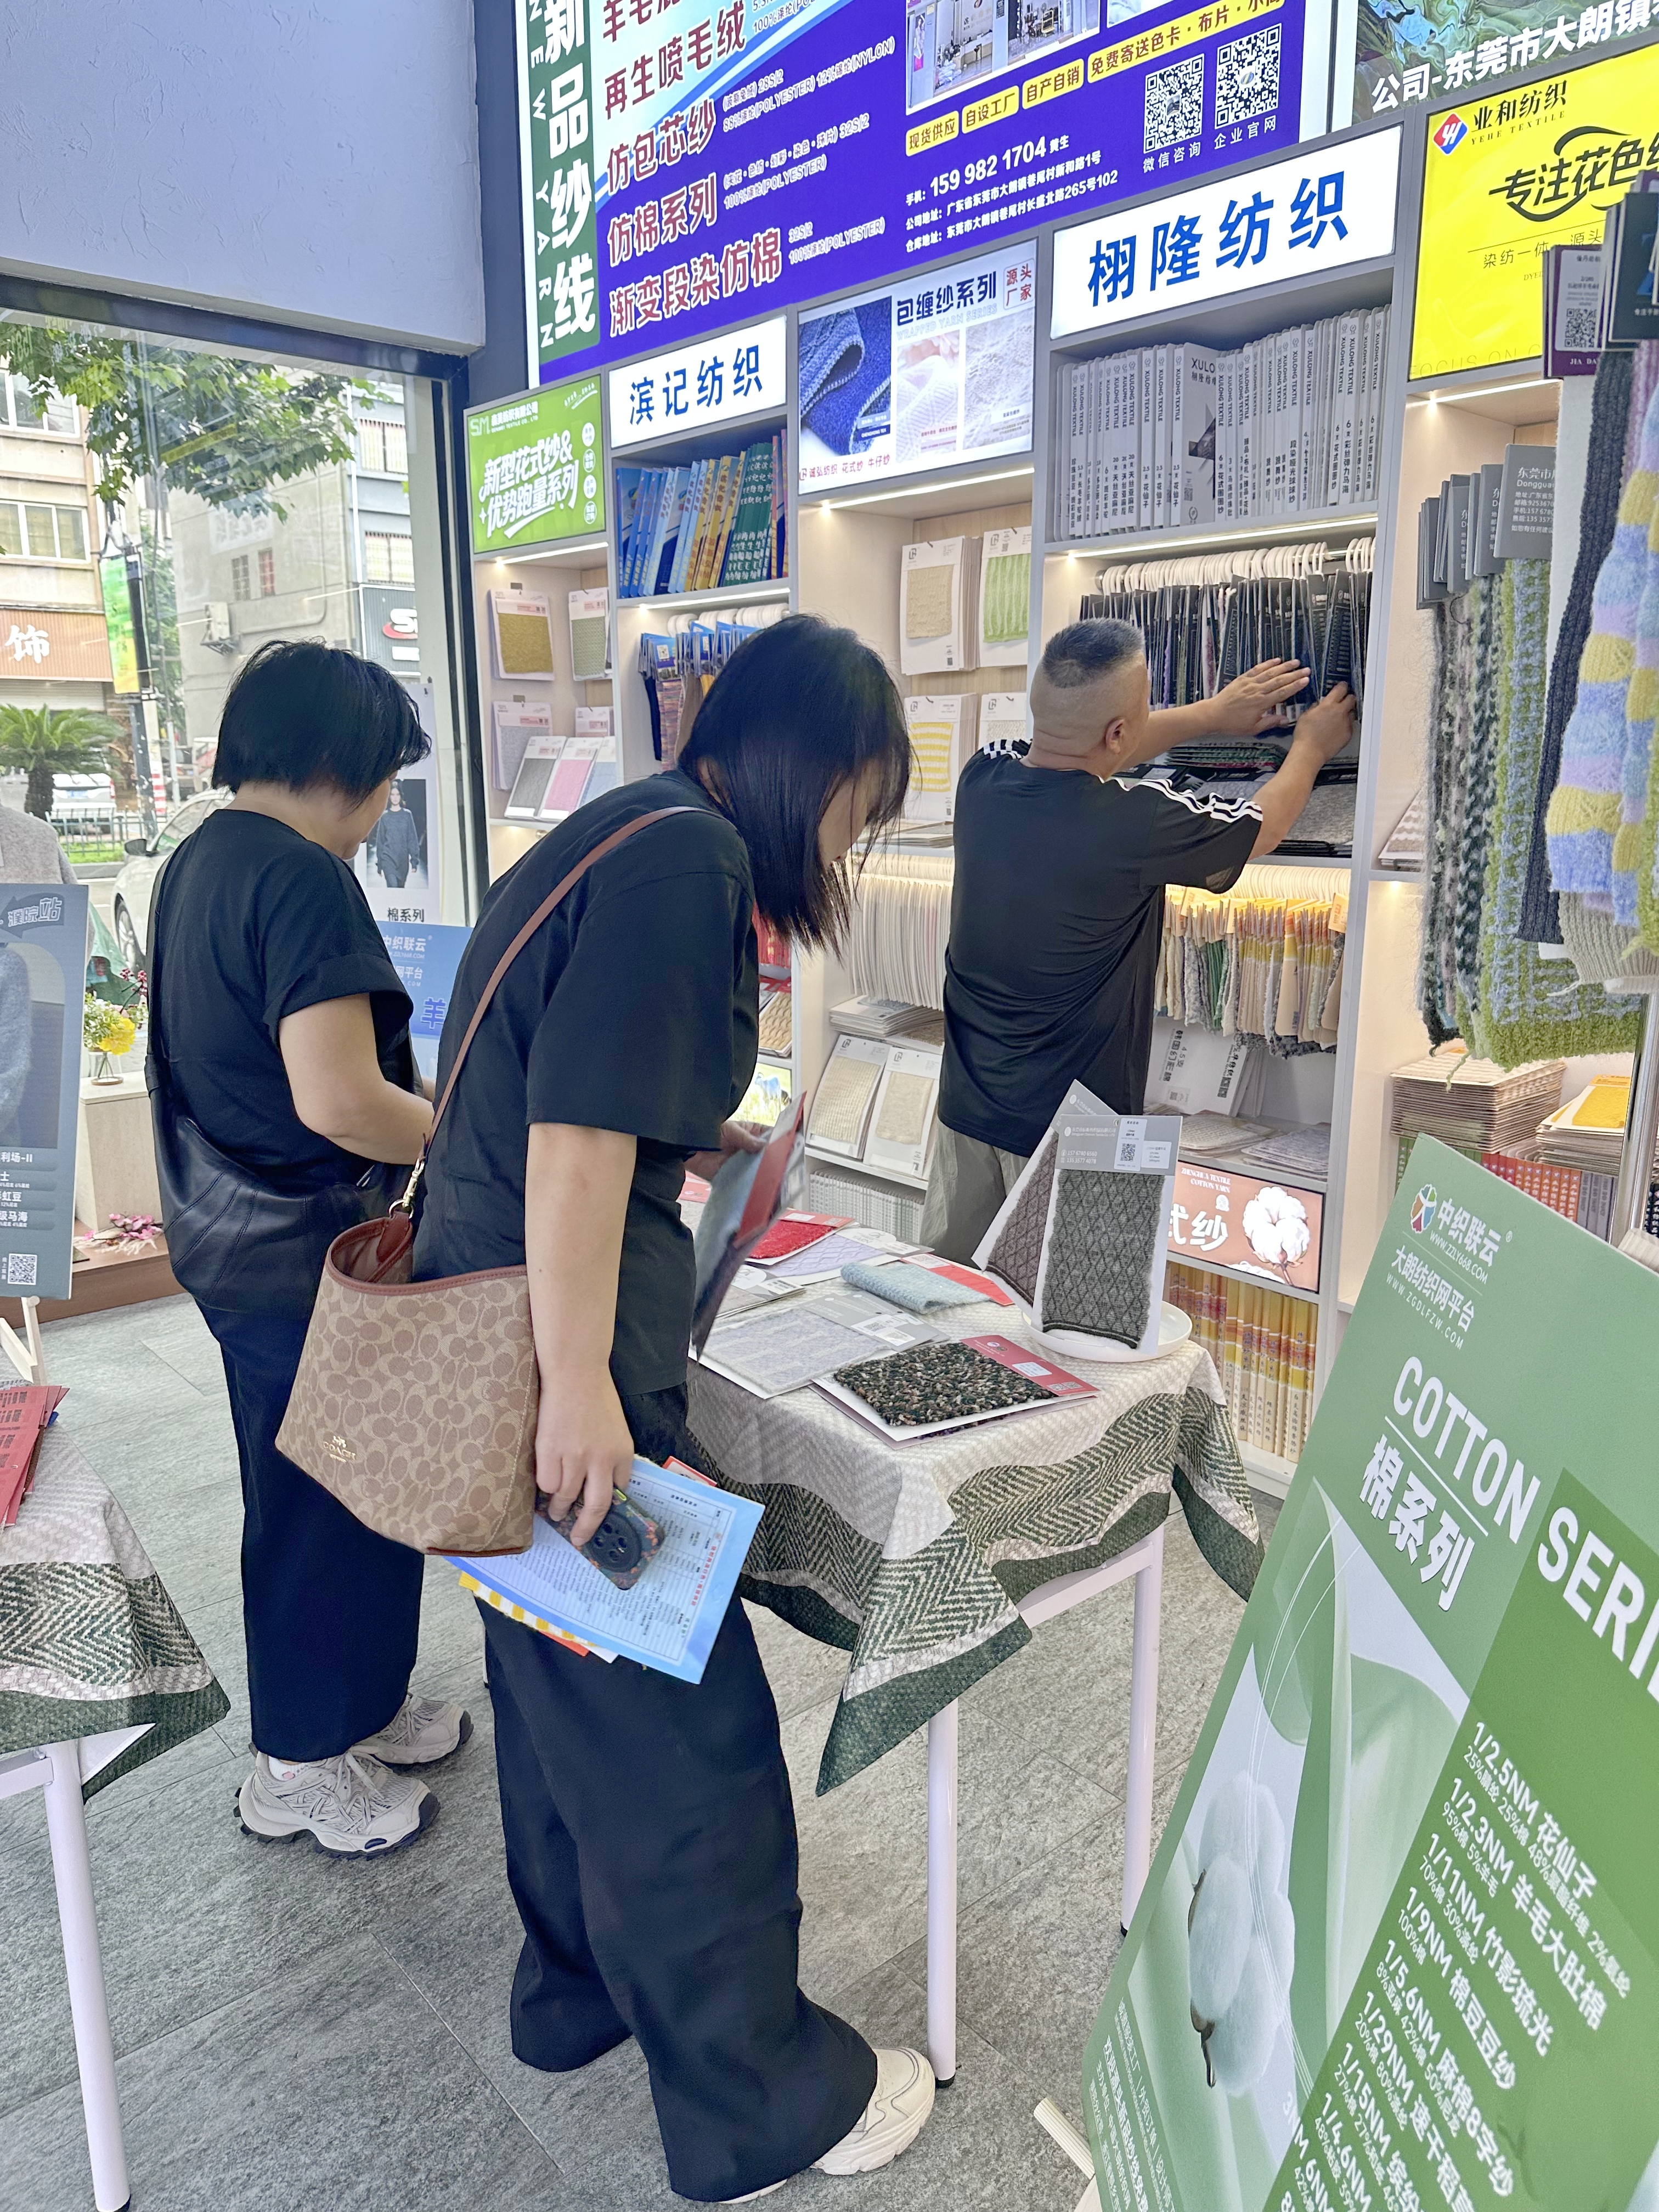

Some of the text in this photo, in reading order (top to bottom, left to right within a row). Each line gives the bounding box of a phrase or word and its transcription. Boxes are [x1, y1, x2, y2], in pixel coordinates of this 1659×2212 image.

[605, 0, 745, 120] 再生喷毛绒
[758, 69, 784, 94] 28S/2
[1027, 65, 1080, 103] 自产自销
[839, 113, 870, 139] 32S/2
[909, 117, 956, 150] 现货供应
[966, 93, 1015, 127] 自设工厂
[1214, 115, 1277, 150] 企业官网
[1471, 110, 1566, 145] YEHE TEXTILE
[1472, 80, 1568, 131] 业和纺织
[544, 0, 596, 339] 新品纱线
[607, 98, 715, 195] 仿包芯纱
[930, 169, 960, 197] 159
[964, 155, 997, 185] 982
[1003, 136, 1046, 171] 1704
[1143, 142, 1201, 173] 微信咨询
[608, 172, 717, 267] 仿棉系列
[1088, 171, 1348, 307] 栩隆纺织
[536, 180, 554, 348] YARN
[610, 227, 782, 337] 渐变段染仿棉
[1007, 263, 1031, 286] 源头
[897, 271, 996, 326] 包缠纱系列
[939, 315, 963, 330] YARN
[967, 303, 997, 321] SERIES
[1006, 284, 1031, 306] 厂家
[630, 345, 763, 425] 滨记纺织
[487, 460, 579, 538] 优势跑量系列
[5, 624, 50, 664] 饰
[387, 907, 425, 923] 棉系列
[1190, 1178, 1215, 1189] COTTON
[1209, 1174, 1231, 1186] TEXTILE
[1430, 1231, 1488, 1284] WWW.ZZLY668.COM
[1437, 1198, 1502, 1267] 中织联云
[1386, 1271, 1464, 1350] WWW.ZGDLFZW.COM
[1391, 1245, 1476, 1333] 大朗纺织网平台
[1393, 1356, 1541, 1544] COTTON
[1359, 1434, 1475, 1611] 棉系列
[1474, 1722, 1598, 1899] 1/2.5NM 花仙子
[1498, 1796, 1530, 1847] 25%棉
[1419, 1855, 1445, 1905] 70%棉
[1442, 1801, 1499, 1898] 95%棉 5%羊毛
[1451, 1778, 1607, 2031] 1/2.3NM 羊毛大肚棉
[1398, 1908, 1426, 1966] 100%棉
[1429, 1833, 1554, 2057] 1/11NM 竹影琉光
[1406, 1886, 1516, 2090] 1/9NM 棉豆豆纱
[1364, 1991, 1414, 2103] 1/29NM
[1385, 1939, 1513, 2197] 1/5.6NM 麻棉8字纱
[1343, 2042, 1391, 2158] 1/15NM
[1156, 2153, 1175, 2212] 设计师
